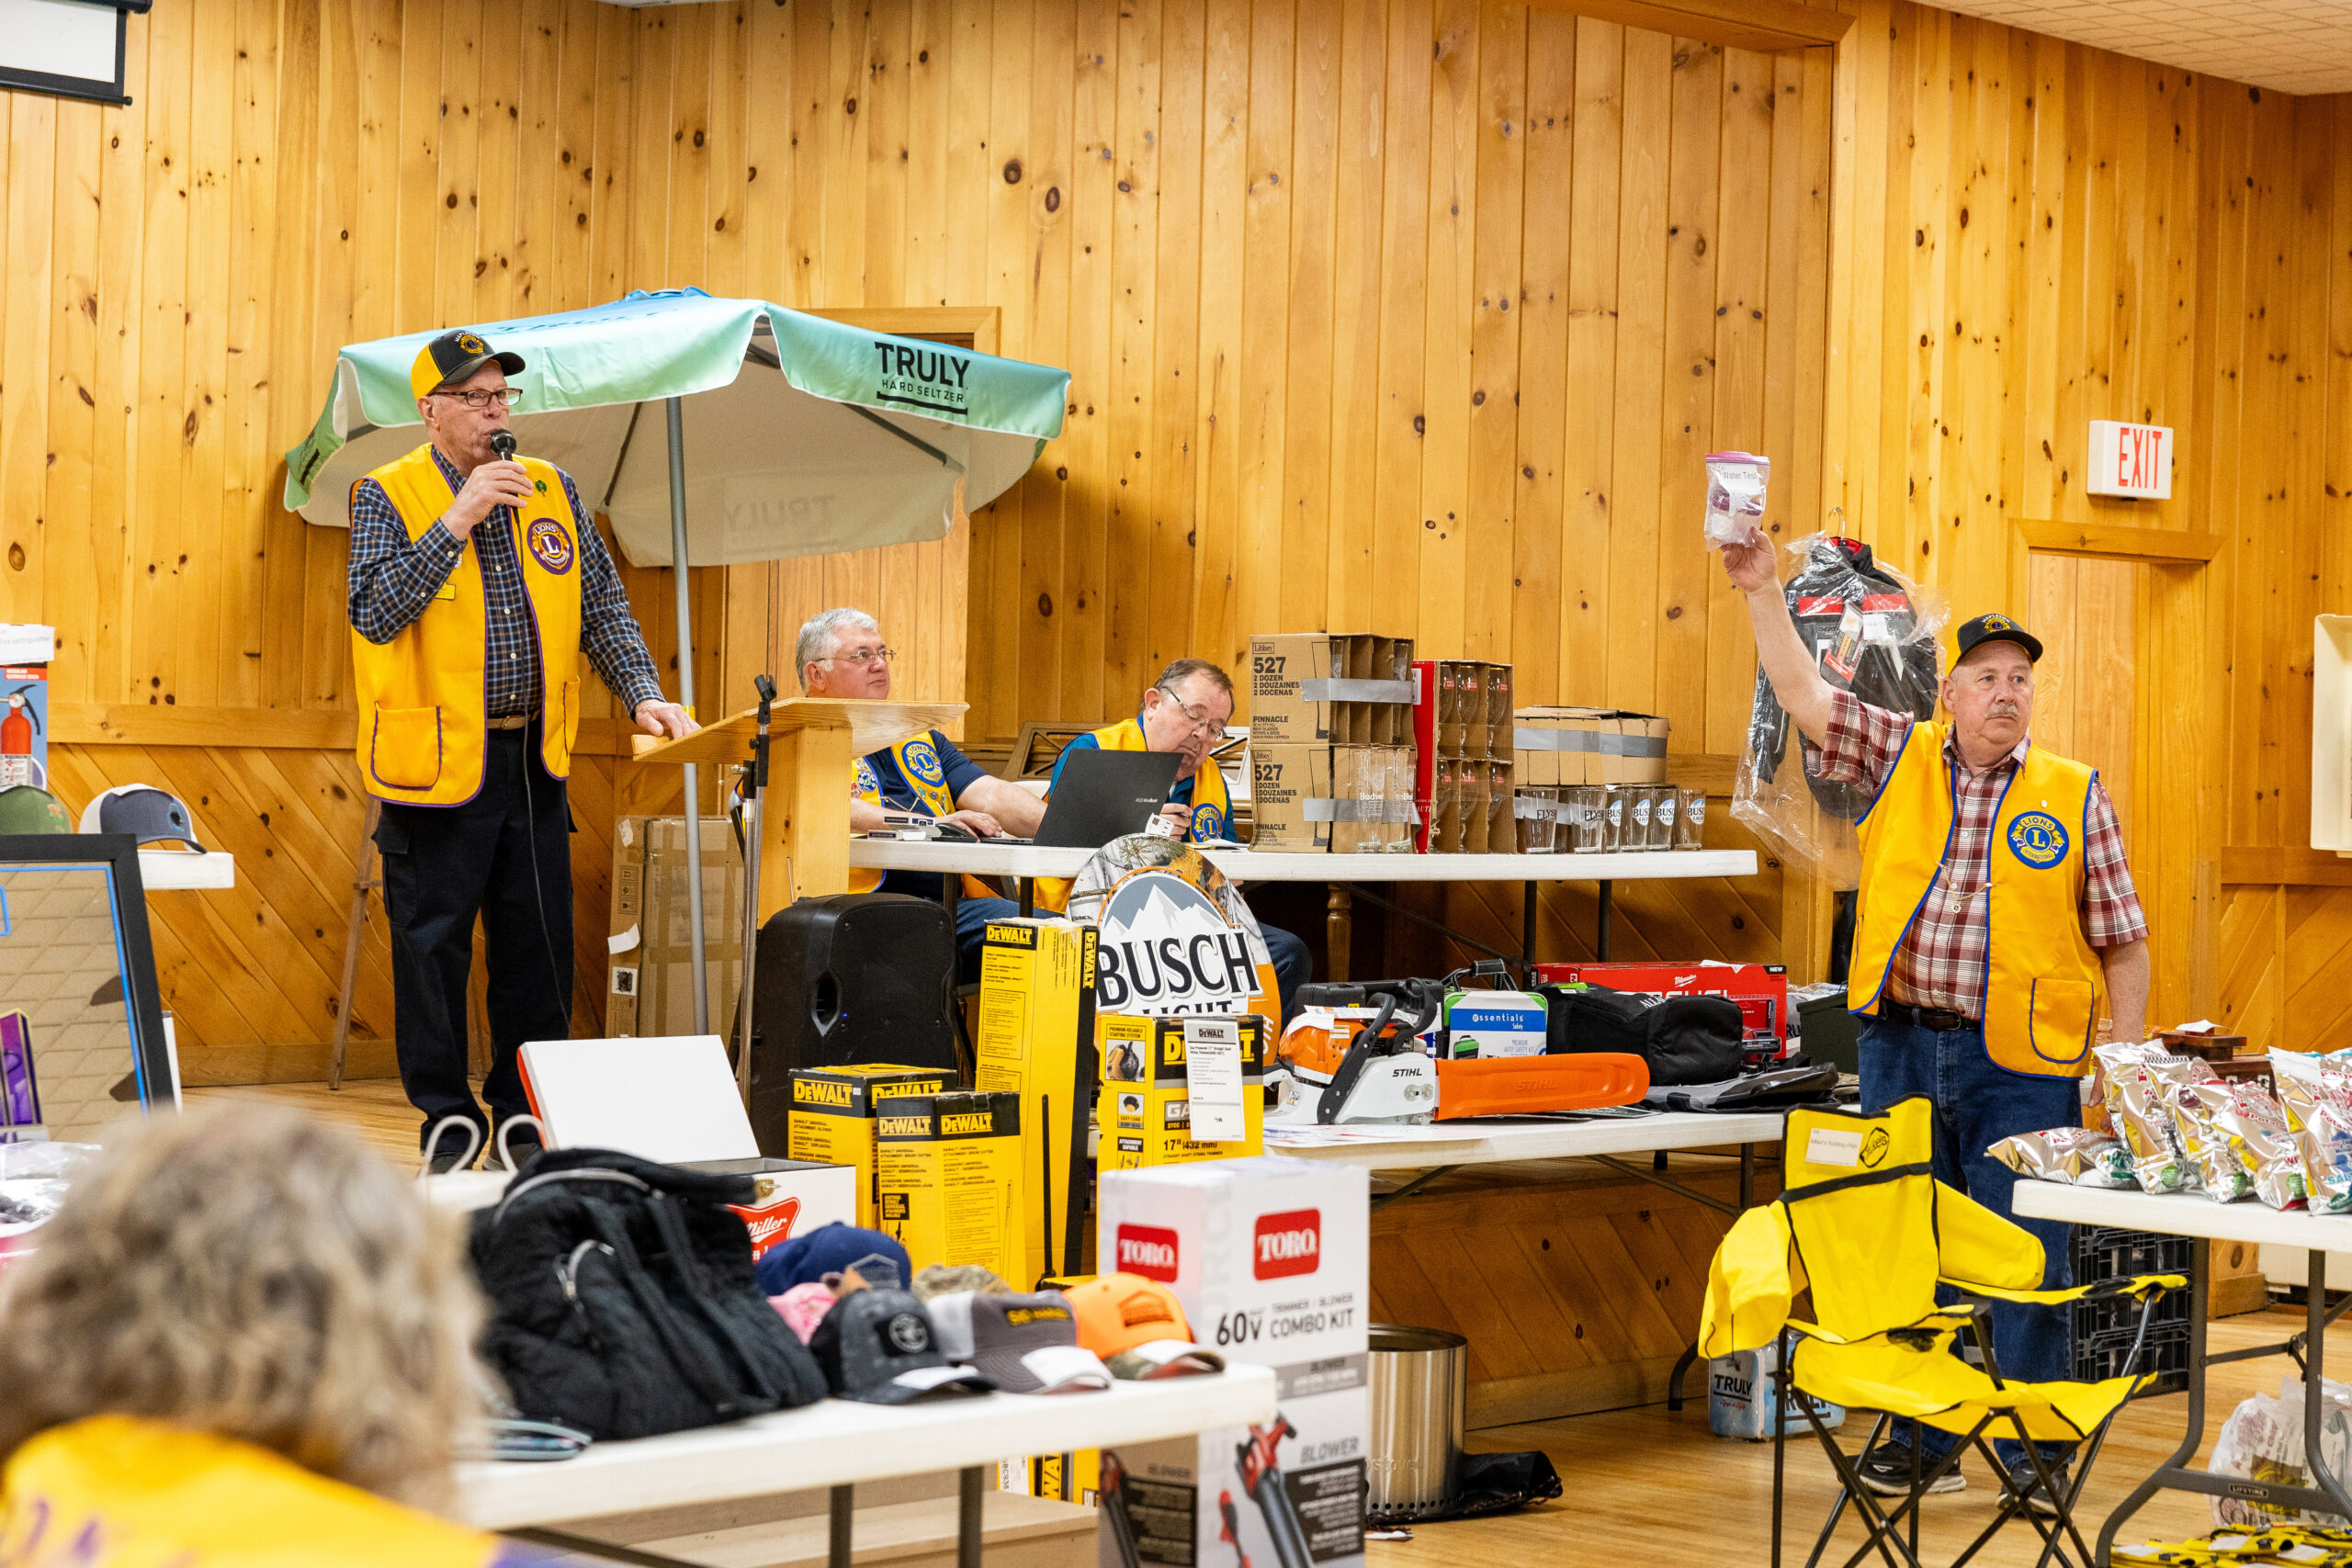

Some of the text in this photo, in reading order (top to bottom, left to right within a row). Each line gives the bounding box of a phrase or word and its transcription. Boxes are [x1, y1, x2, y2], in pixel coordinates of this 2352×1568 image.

[875, 341, 971, 389] TRULY
[882, 378, 965, 403] HARD SELTZER
[2118, 427, 2163, 490] EXIT
[1722, 471, 1742, 479] Water
[534, 524, 557, 535] LIONS
[542, 536, 560, 554] L
[1254, 644, 1273, 653] Libbey
[1253, 656, 1286, 674] 527
[909, 744, 929, 756] LIONS
[919, 755, 933, 770] L
[1254, 764, 1283, 781] 527
[1199, 808, 1219, 819] LIONS
[1537, 809, 1557, 821] ELYS
[1585, 809, 1604, 821] ELYS
[1607, 809, 1622, 818] BUS
[1633, 808, 1650, 818] BUS
[1656, 807, 1675, 817] BUSC
[1207, 819, 1216, 835] L
[2022, 817, 2053, 829] LIONS
[2031, 829, 2046, 847] L
[1100, 931, 1261, 1008] BUSCH
[1674, 974, 1697, 985] Milwaukee
[1472, 1013, 1524, 1022] essentials
[1512, 1022, 1523, 1031] Safety
[1392, 1068, 1422, 1077] STIHL
[1515, 1080, 1557, 1091] STIHL
[1167, 1103, 1191, 1118] GA
[746, 1215, 788, 1237] Miller
[1257, 1228, 1317, 1262] TORO
[1119, 1239, 1174, 1268] TORO
[1216, 1313, 1262, 1346] 60V
[1270, 1308, 1354, 1338] COMBO KIT
[1714, 1373, 1753, 1396] TRULY
[1300, 1436, 1360, 1464] BLOWER
[2233, 1485, 2264, 1496] LIFETIME
